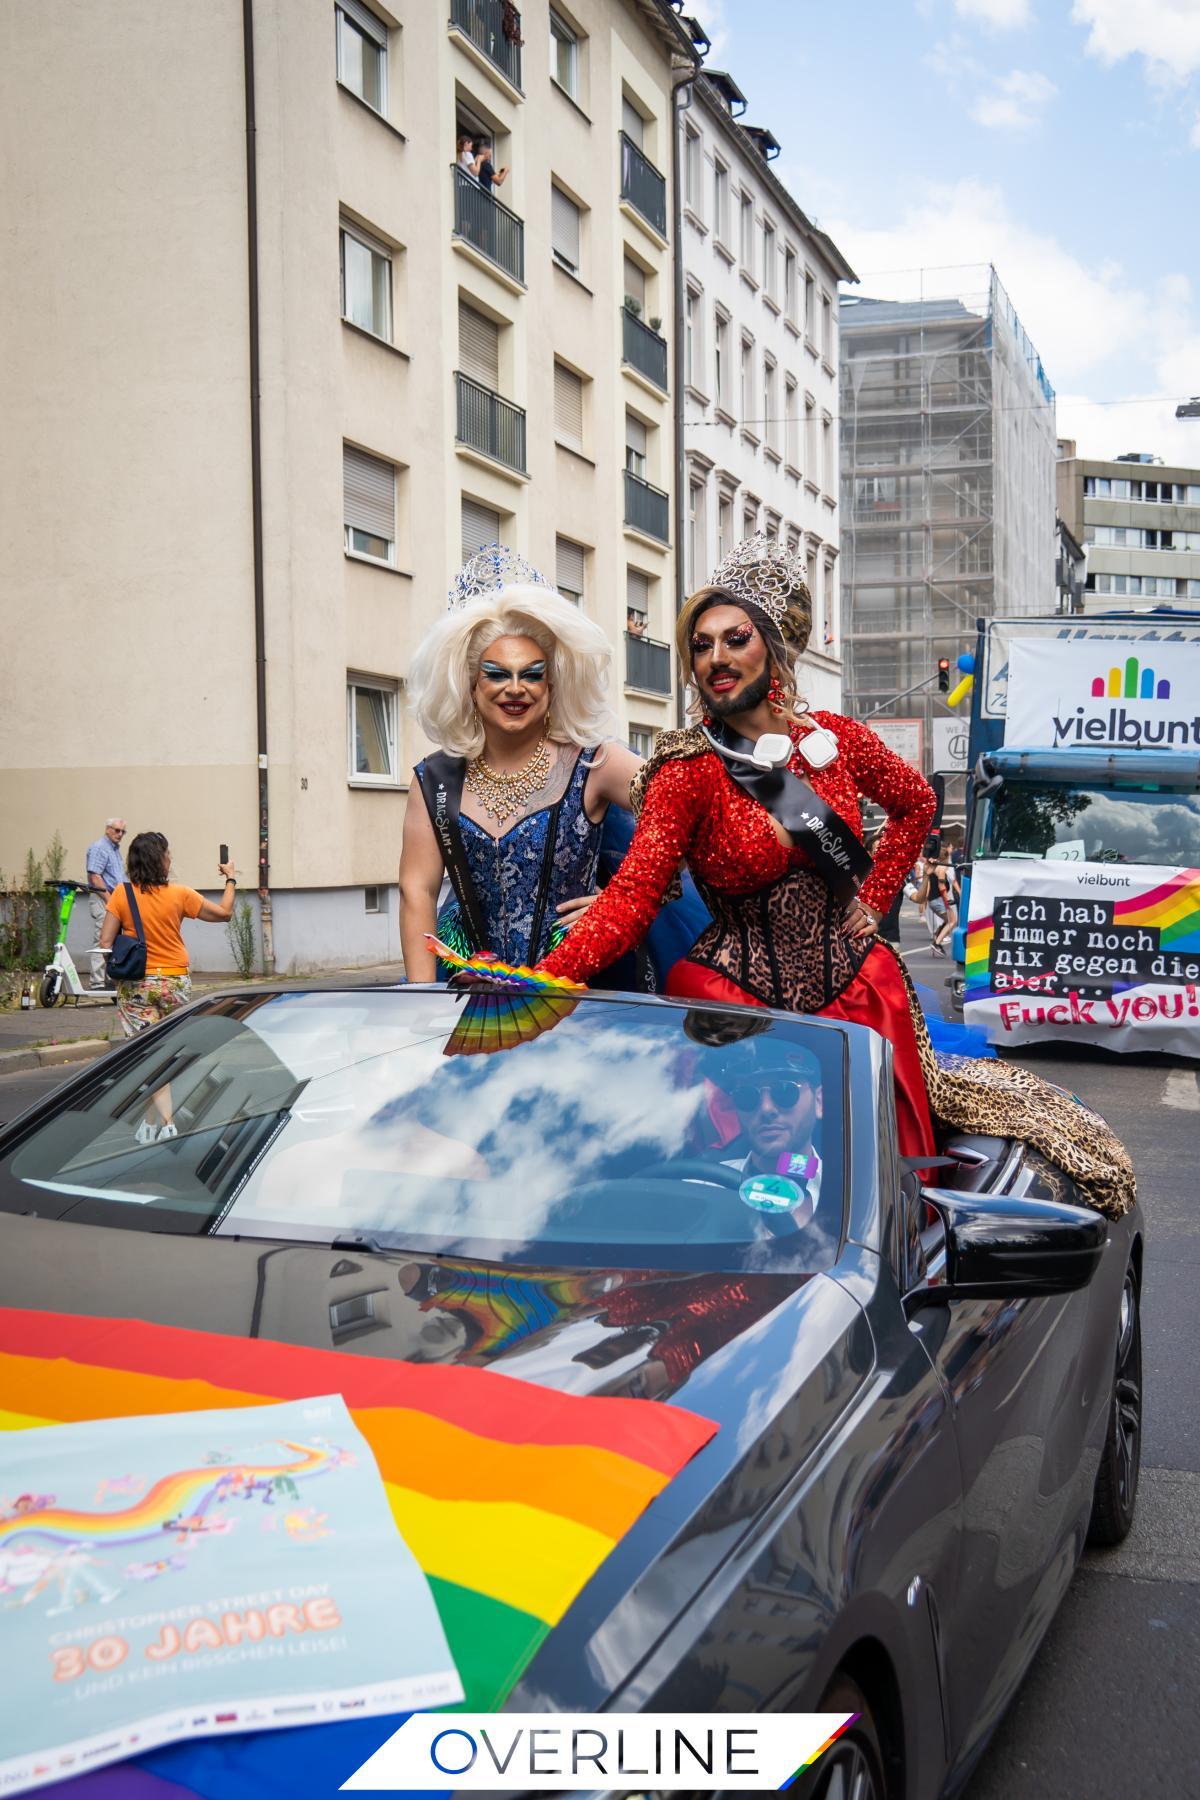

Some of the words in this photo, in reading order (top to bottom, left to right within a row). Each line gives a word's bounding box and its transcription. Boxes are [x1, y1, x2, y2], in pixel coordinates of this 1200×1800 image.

[1052, 707, 1200, 744] vielbunt
[1077, 872, 1131, 887] vielbunt
[1000, 899, 1047, 921] Ich
[1059, 901, 1107, 925] hab
[1000, 922, 1078, 947] immer
[1087, 929, 1154, 952] noch
[995, 947, 1044, 968] nix
[1054, 952, 1138, 976] gegen
[1150, 955, 1200, 980] die
[999, 991, 1098, 1032] Fuck
[1105, 982, 1200, 1029] you!
[206, 1588, 286, 1614] STREET
[289, 1582, 330, 1599] DAY
[49, 1634, 129, 1683] 30
[144, 1596, 342, 1661] JAHRE
